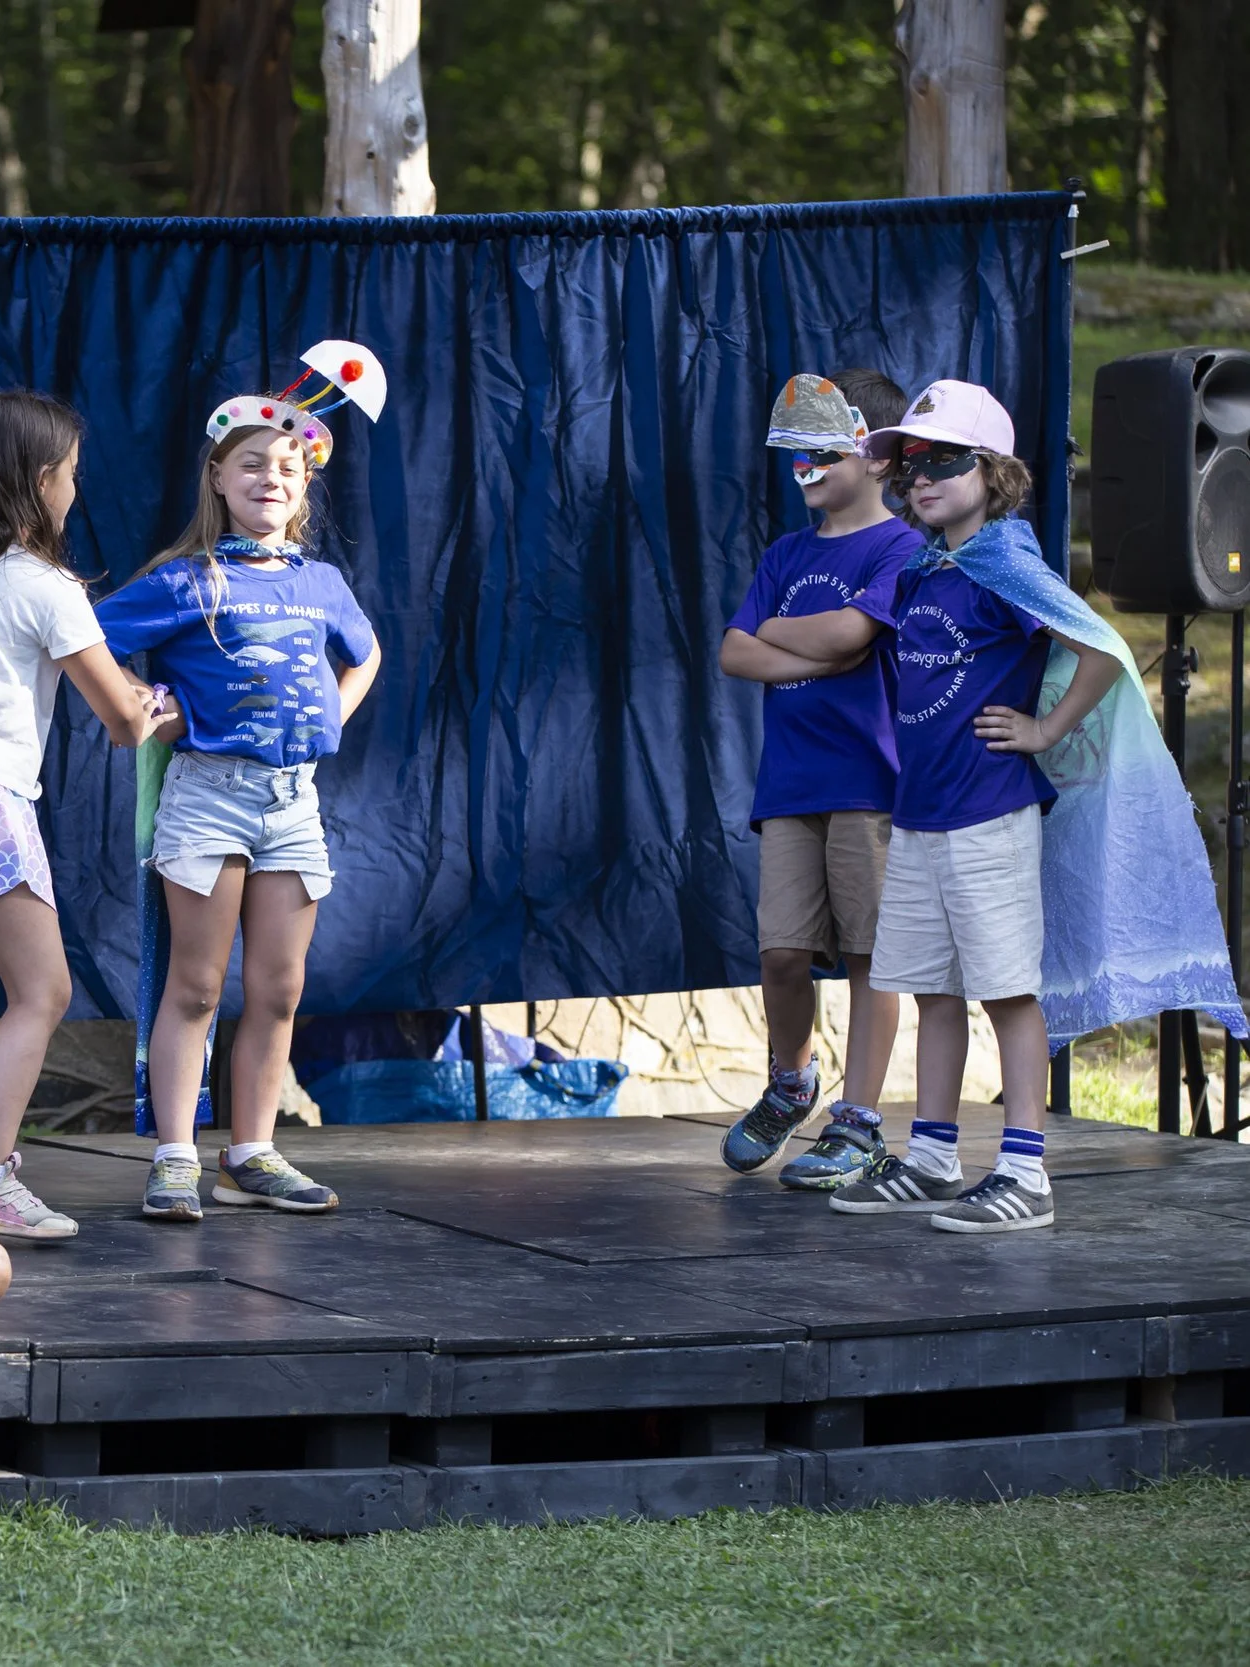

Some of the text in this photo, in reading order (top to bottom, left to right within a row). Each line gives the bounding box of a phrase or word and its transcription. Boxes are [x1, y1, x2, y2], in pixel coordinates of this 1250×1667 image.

[830, 576, 839, 587] 5
[221, 603, 326, 619] TYPES OF WHALES
[941, 613, 970, 648] YEARS
[917, 697, 949, 722] STATE
[946, 670, 967, 699] PARK
